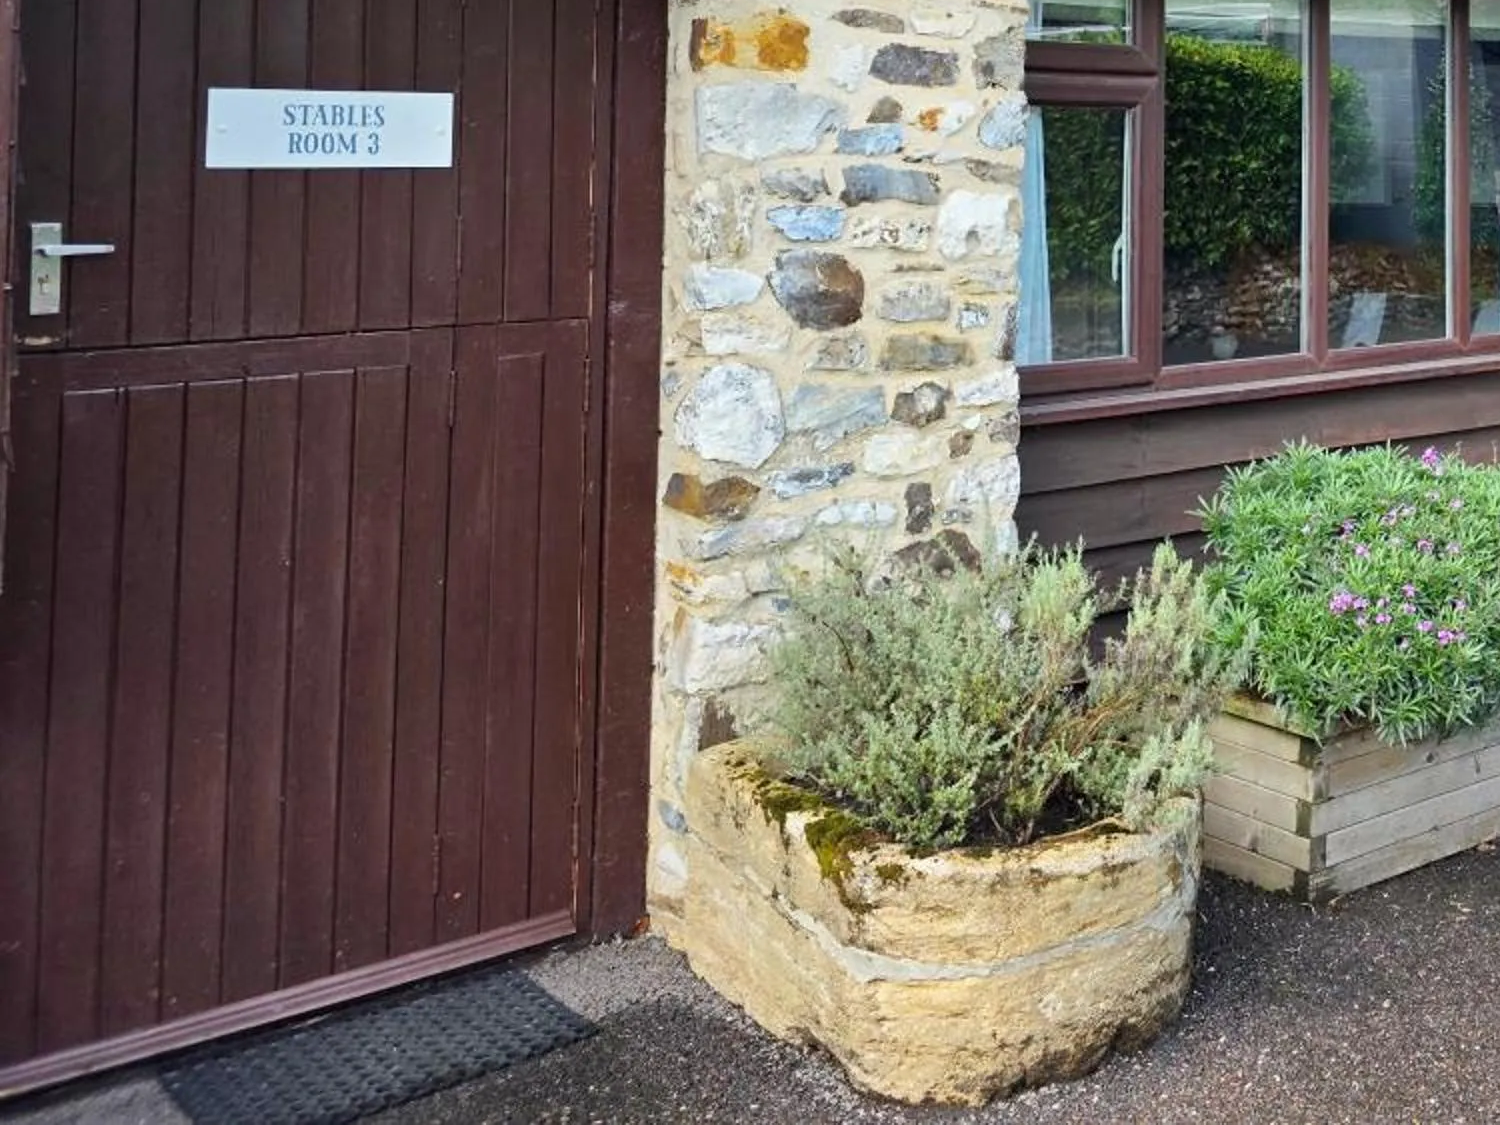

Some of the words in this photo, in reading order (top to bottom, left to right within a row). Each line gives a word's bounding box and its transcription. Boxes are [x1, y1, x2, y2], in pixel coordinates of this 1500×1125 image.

[283, 104, 385, 127] STABLES
[288, 132, 357, 154] ROOM
[367, 132, 380, 155] 3
